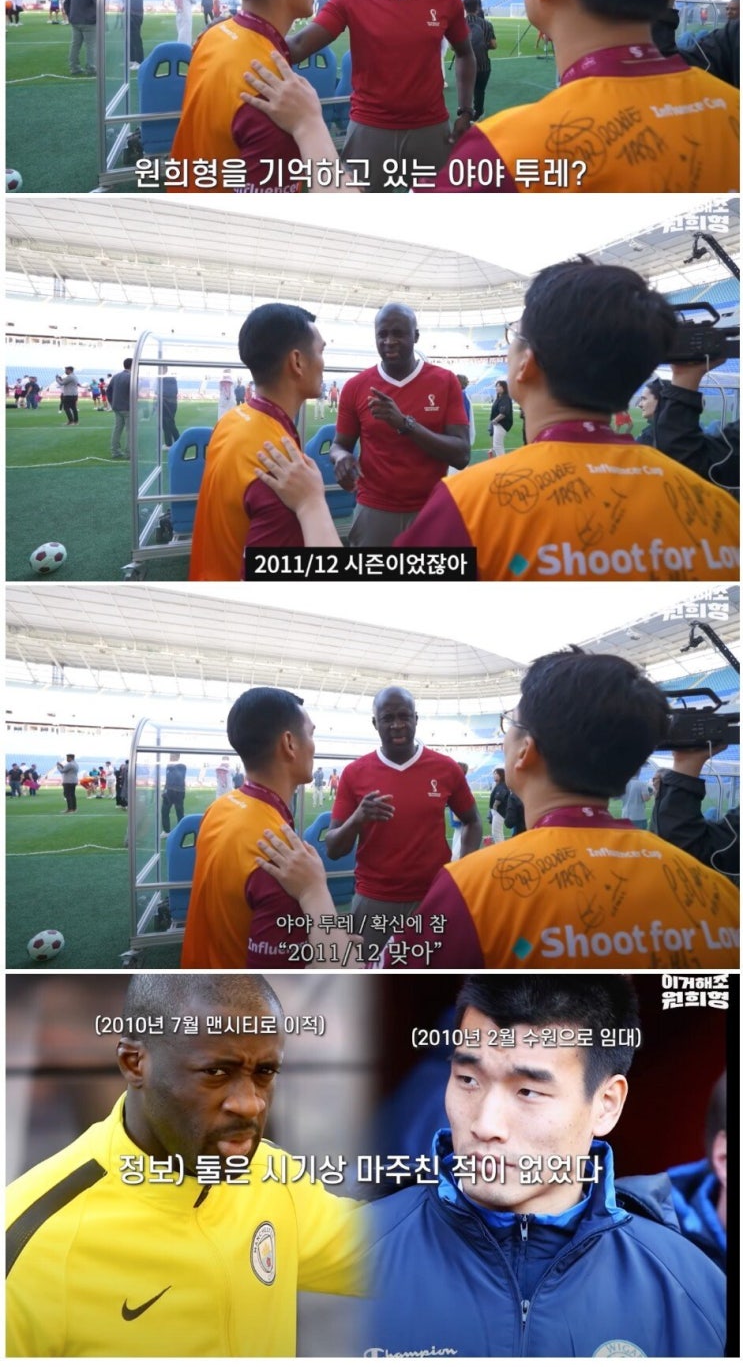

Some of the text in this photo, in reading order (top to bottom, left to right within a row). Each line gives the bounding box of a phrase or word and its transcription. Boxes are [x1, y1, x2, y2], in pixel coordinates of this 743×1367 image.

[537, 542, 647, 576] Shoot
[650, 538, 696, 570] for
[541, 924, 647, 958] Shoot
[650, 920, 696, 951] for
